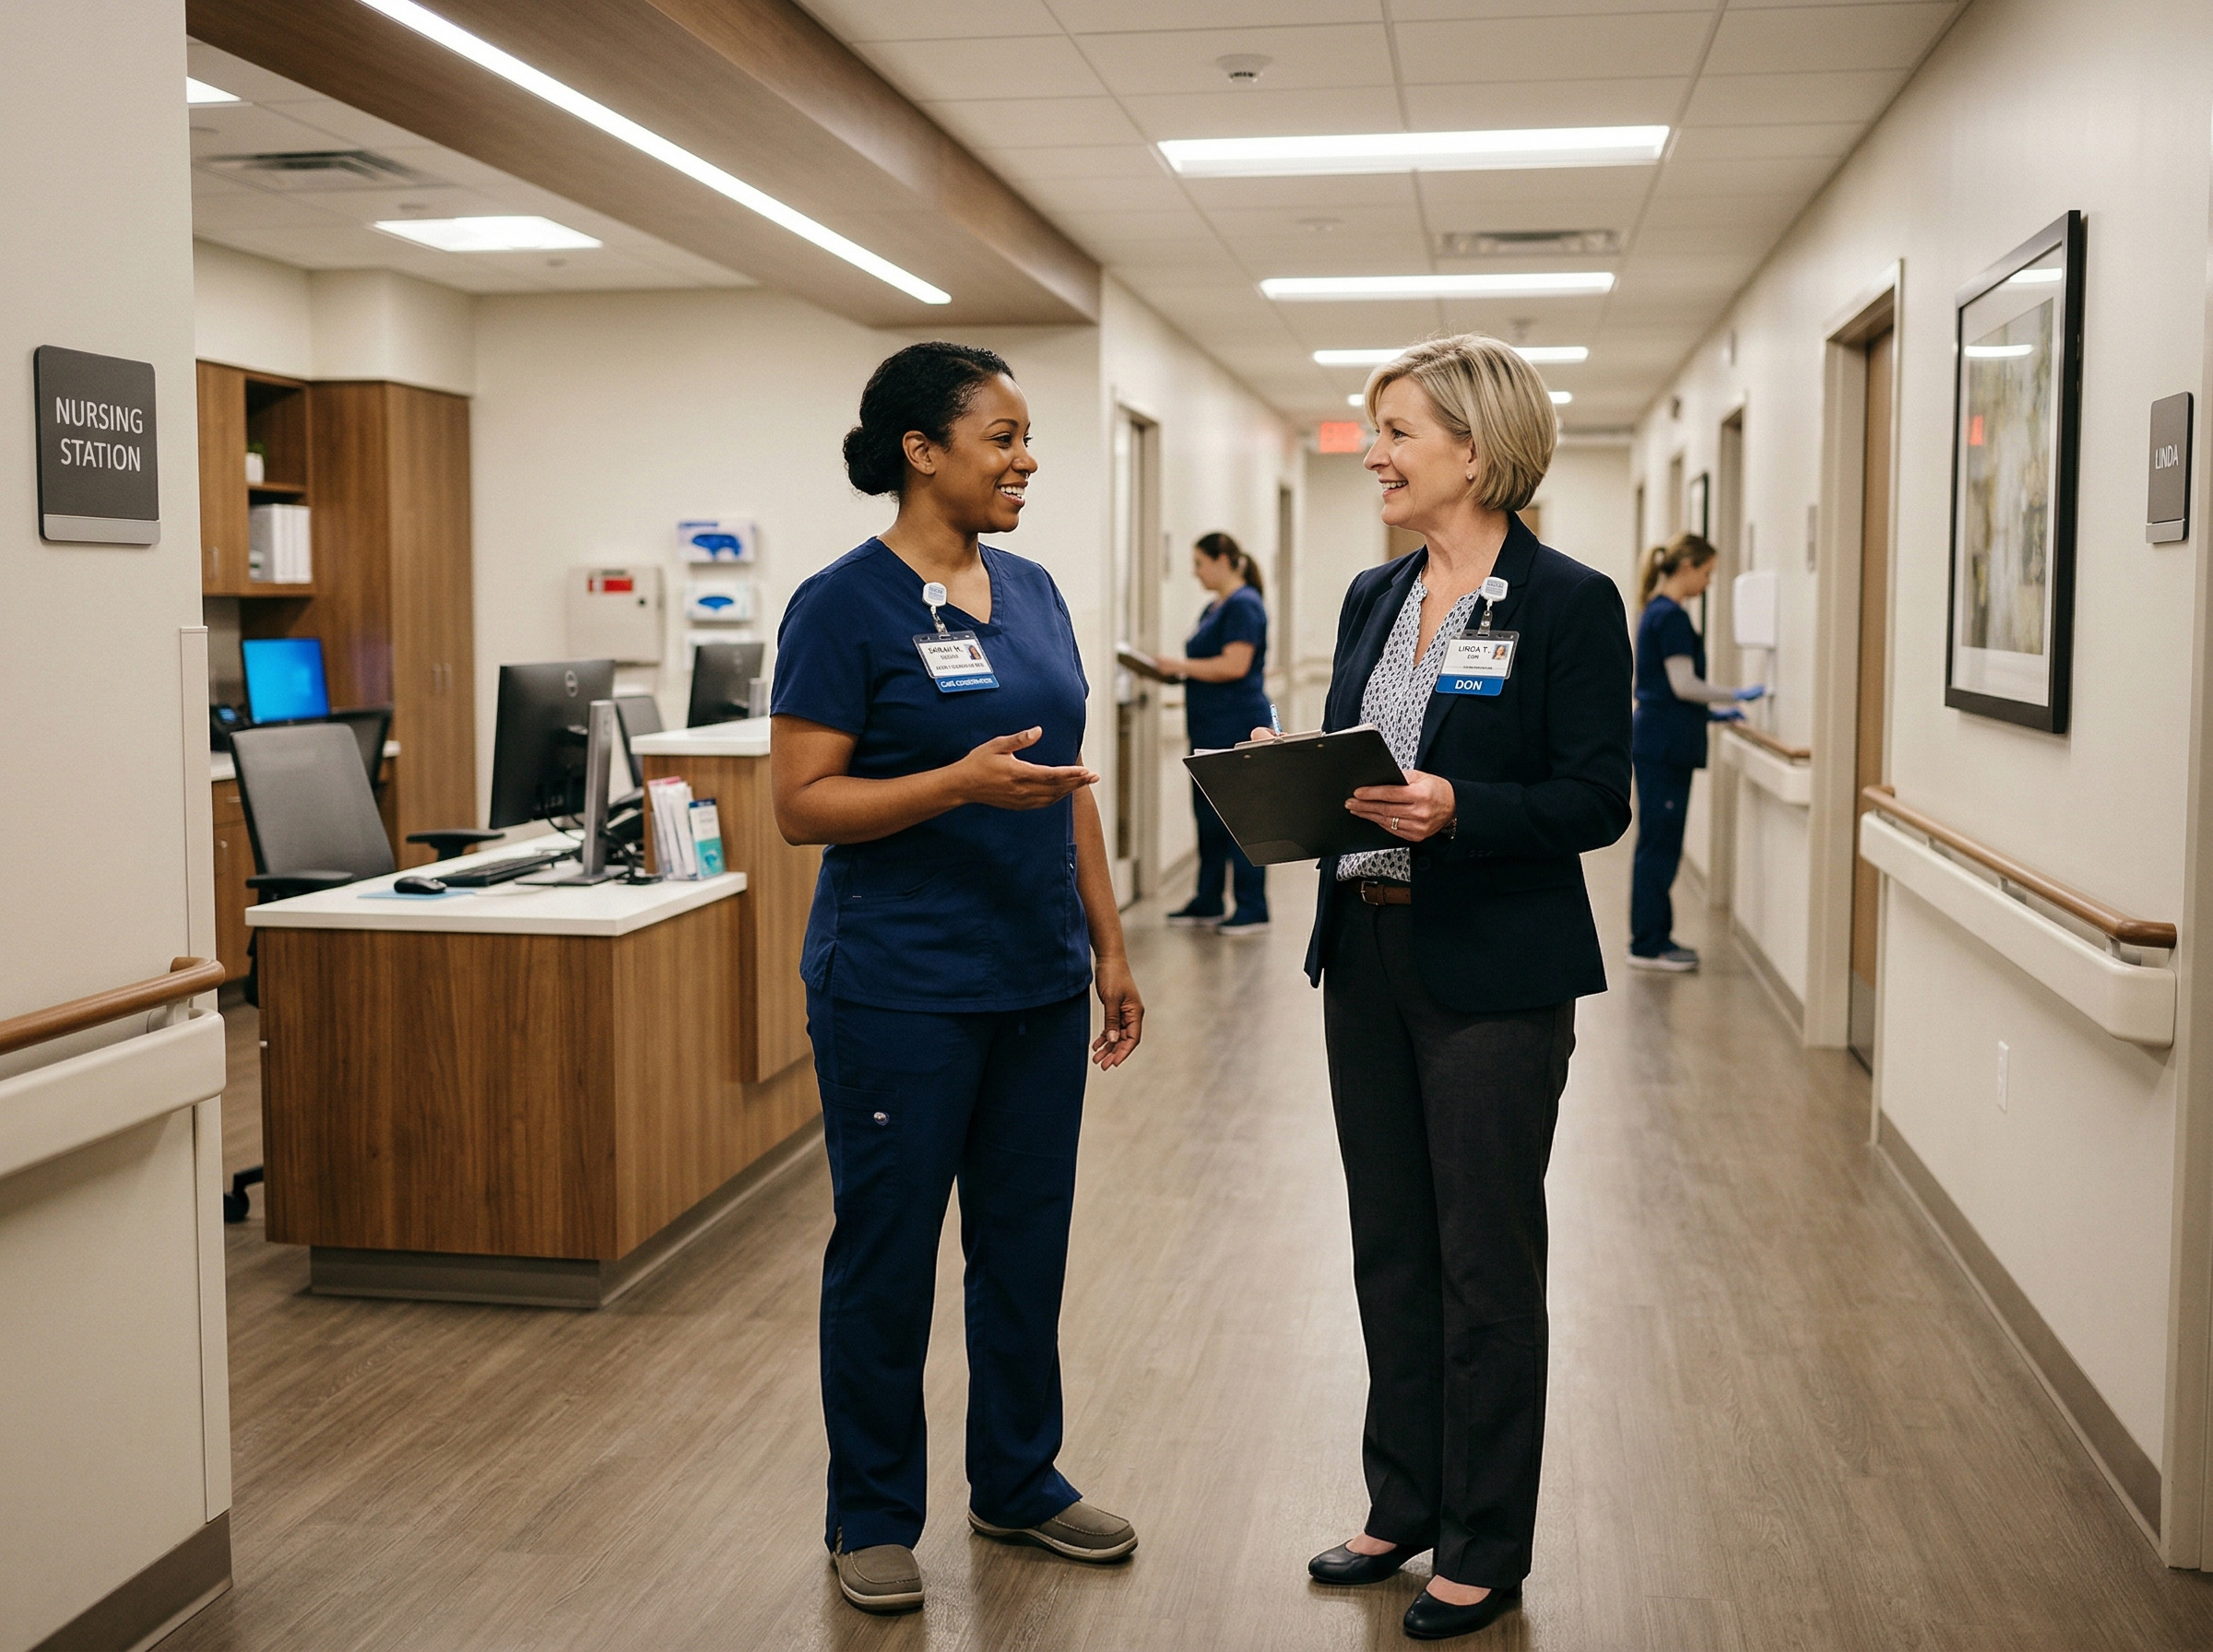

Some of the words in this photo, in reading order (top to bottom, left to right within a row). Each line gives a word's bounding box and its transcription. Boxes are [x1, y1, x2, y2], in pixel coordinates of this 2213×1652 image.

[55, 396, 144, 434] NURSING
[60, 438, 141, 473] STATION
[2155, 443, 2179, 470] LINDA
[1454, 679, 1483, 690] DON
